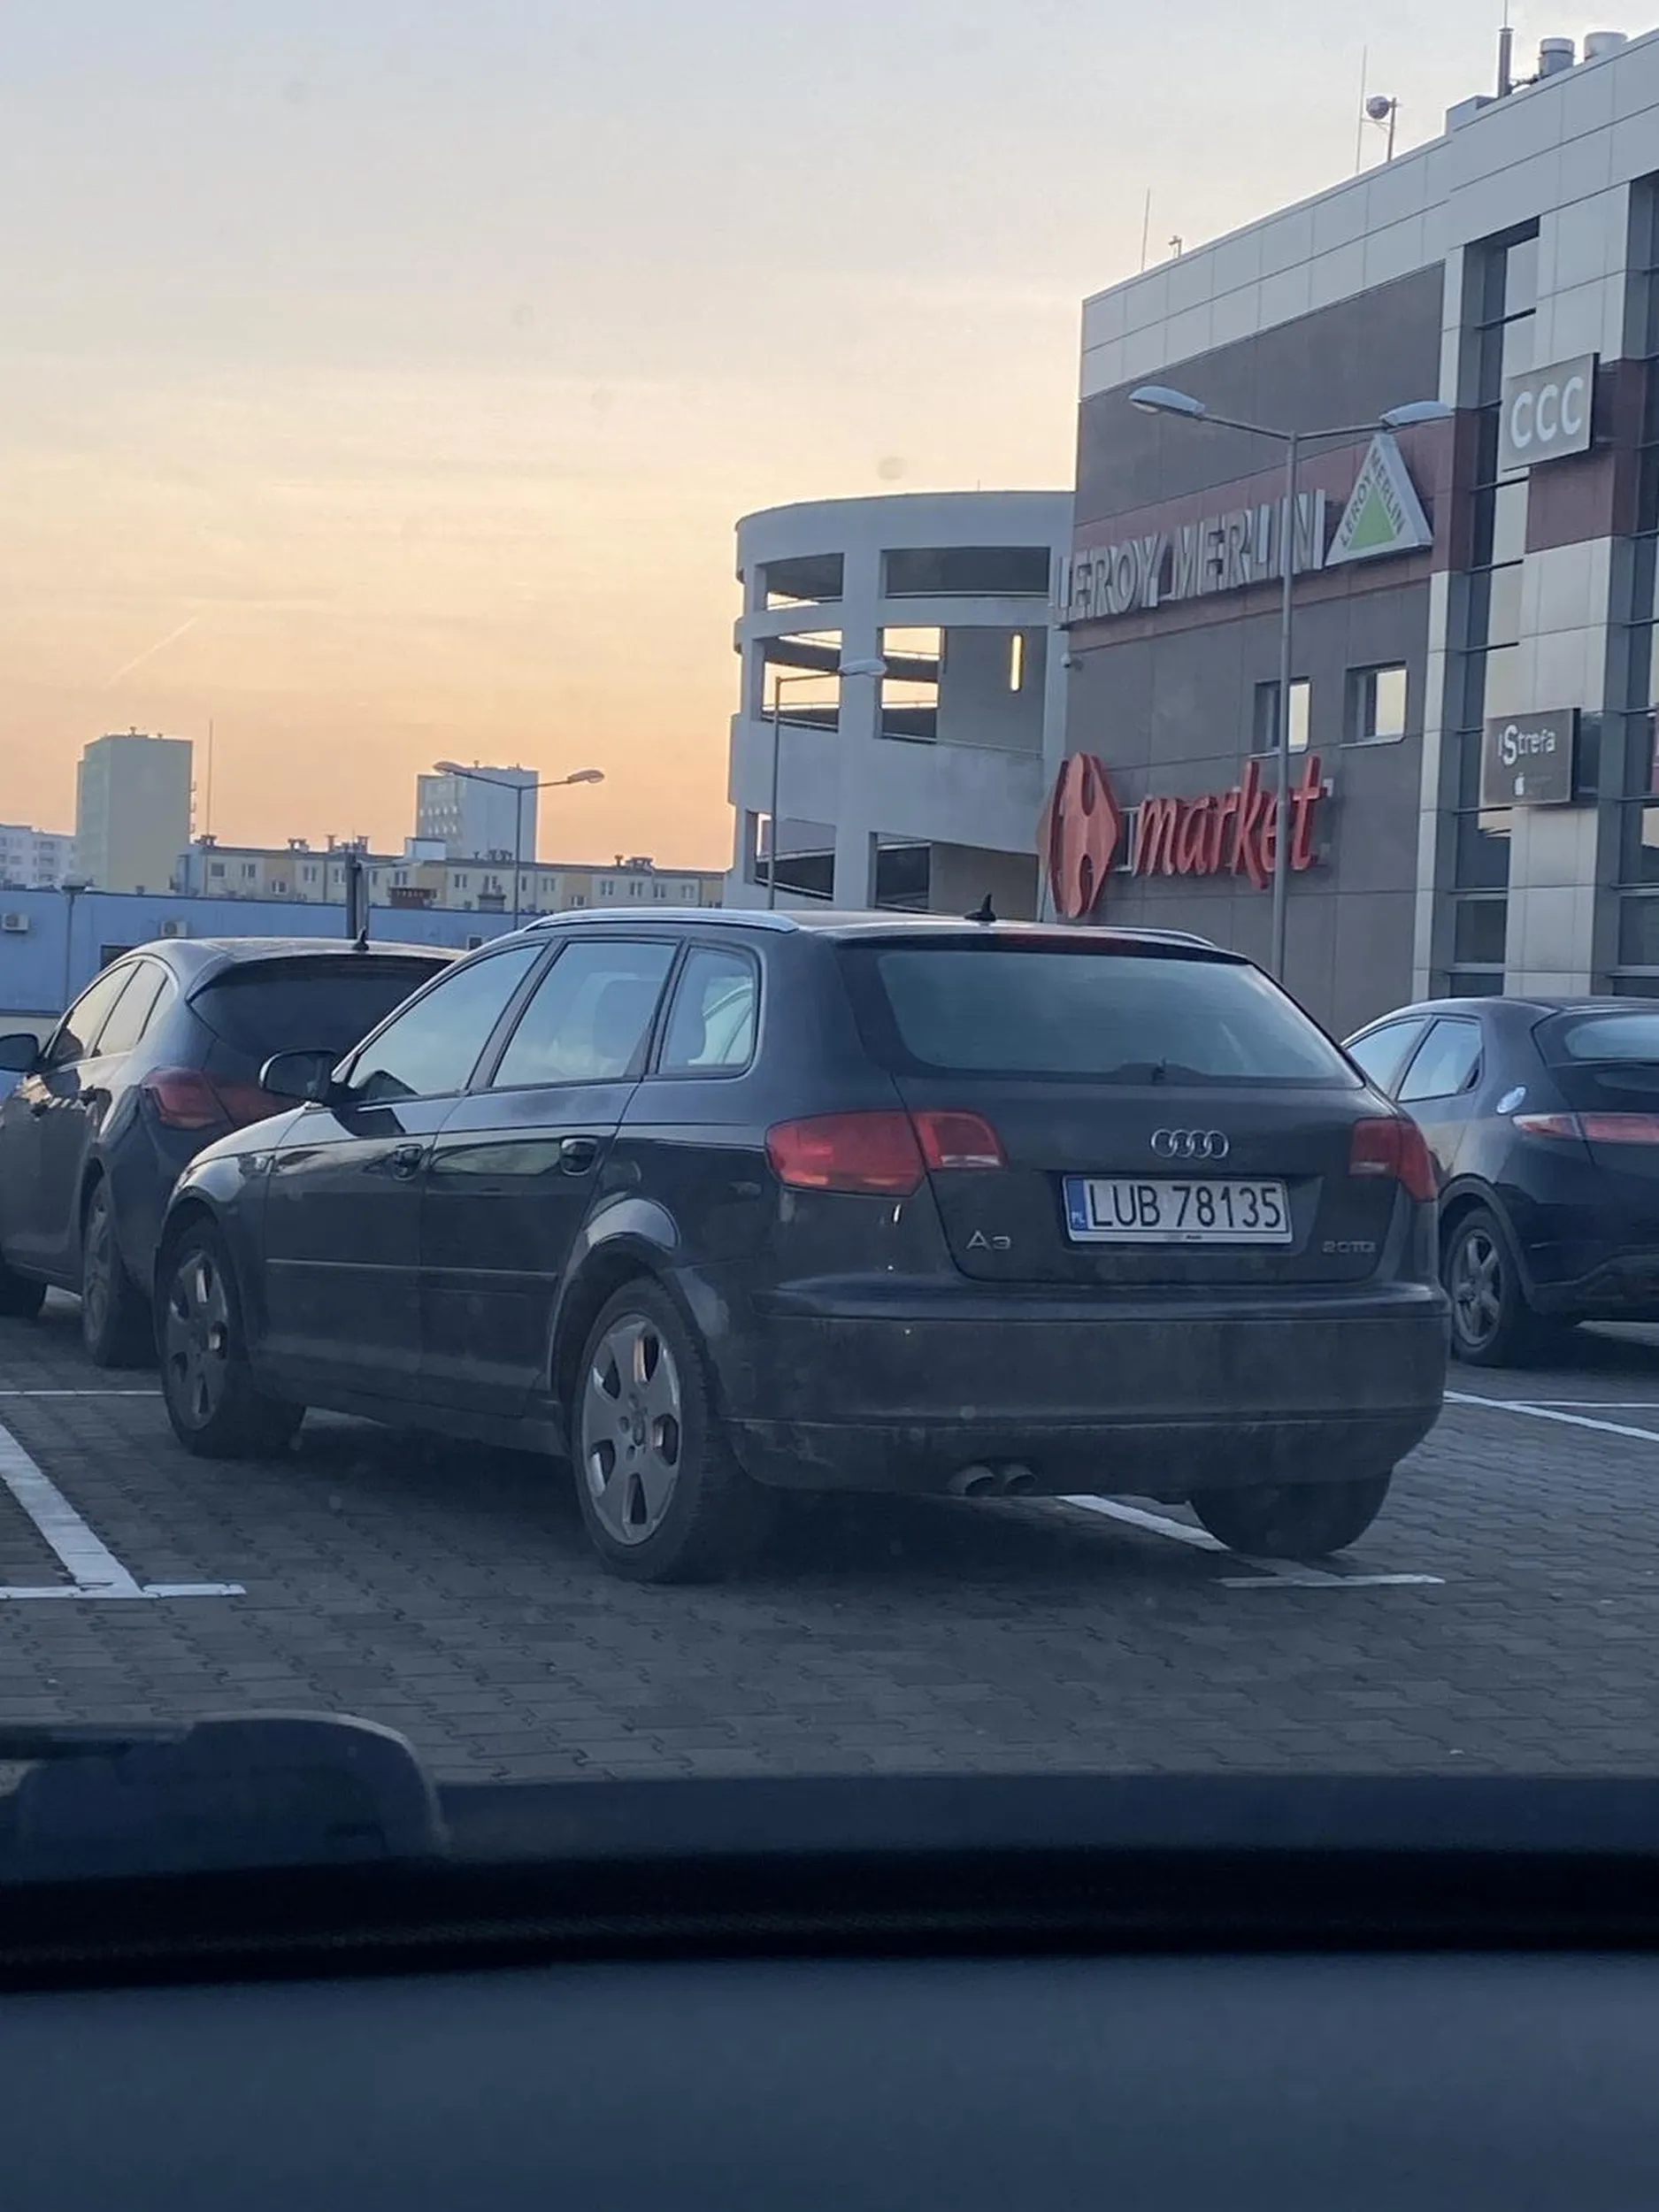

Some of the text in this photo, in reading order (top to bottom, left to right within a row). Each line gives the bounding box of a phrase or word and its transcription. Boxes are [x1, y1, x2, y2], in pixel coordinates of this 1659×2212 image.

[1510, 376, 1584, 449] CCC
[1055, 489, 1325, 620] LEROY MERLIN
[1131, 755, 1327, 890] market
[965, 1230, 1011, 1249] A3
[1089, 1184, 1280, 1228] LUB 78135
